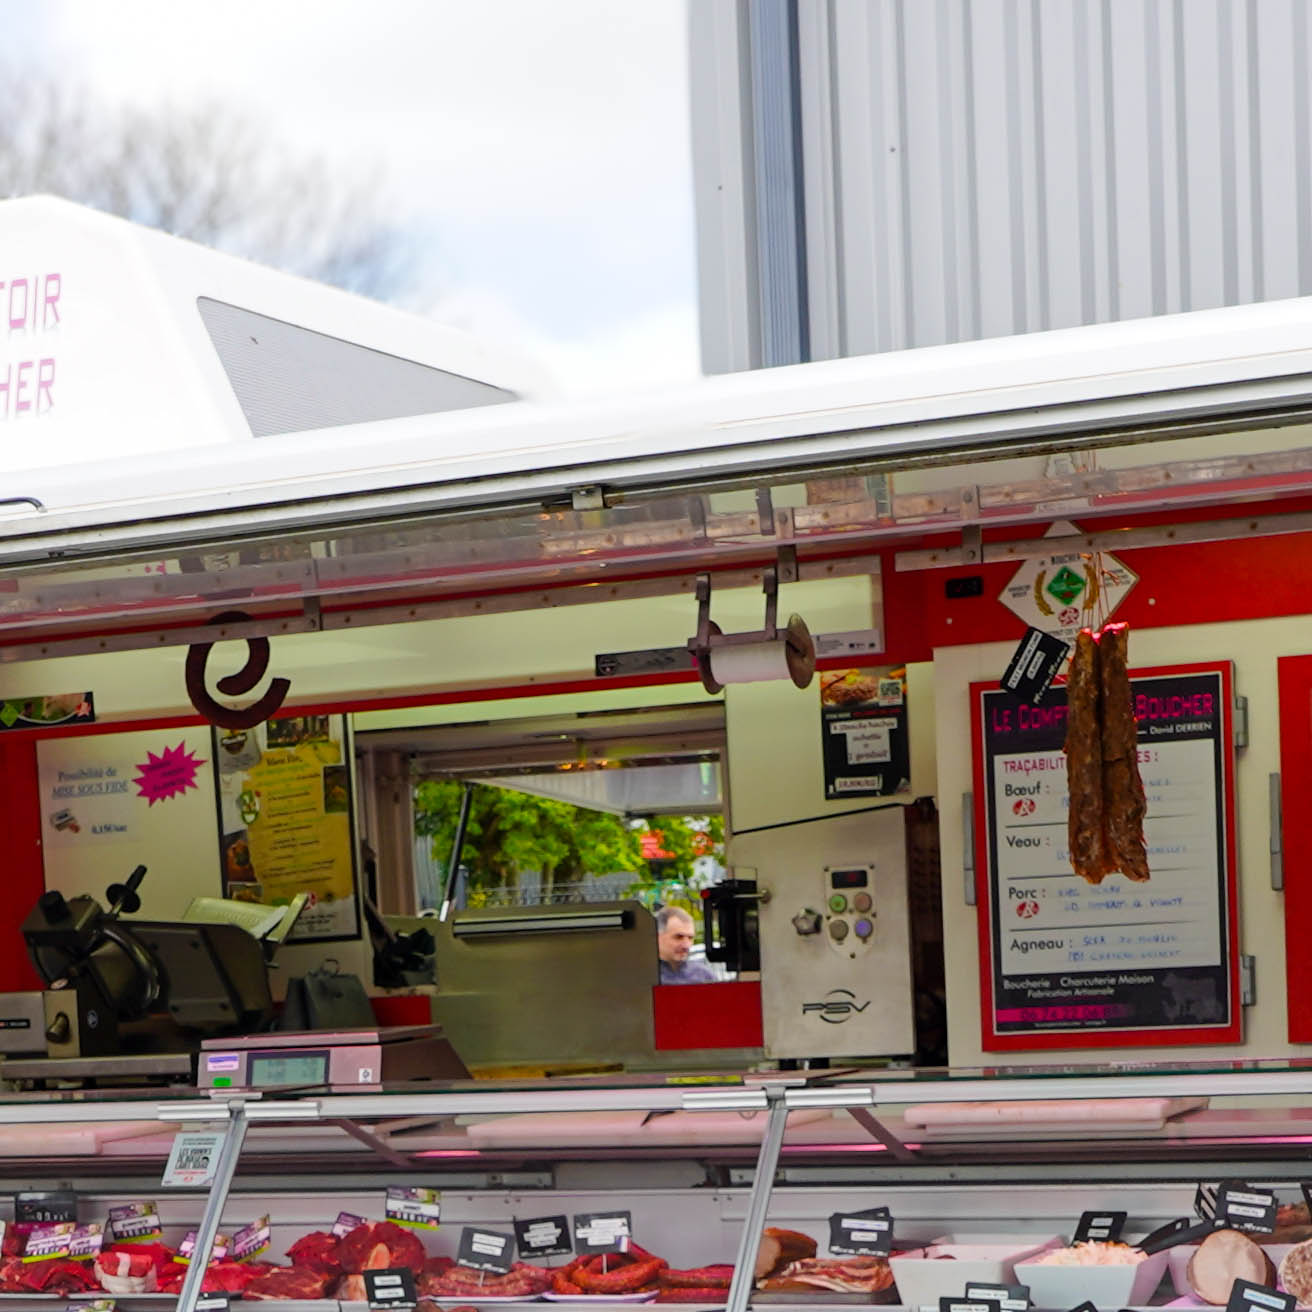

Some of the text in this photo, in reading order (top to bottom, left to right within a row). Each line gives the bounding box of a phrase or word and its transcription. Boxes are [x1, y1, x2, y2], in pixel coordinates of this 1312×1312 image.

[1018, 704, 1070, 730] COMPT
[1175, 721, 1212, 733] DERRIEN
[1003, 756, 1065, 776] TRAÇABILIT
[1005, 781, 1041, 796] Bœuf
[1006, 835, 1040, 848] Veau
[1008, 886, 1037, 900] Porc
[1010, 938, 1064, 954] Agneau
[1003, 974, 1155, 990] Boucherie Charcuterie Maison
